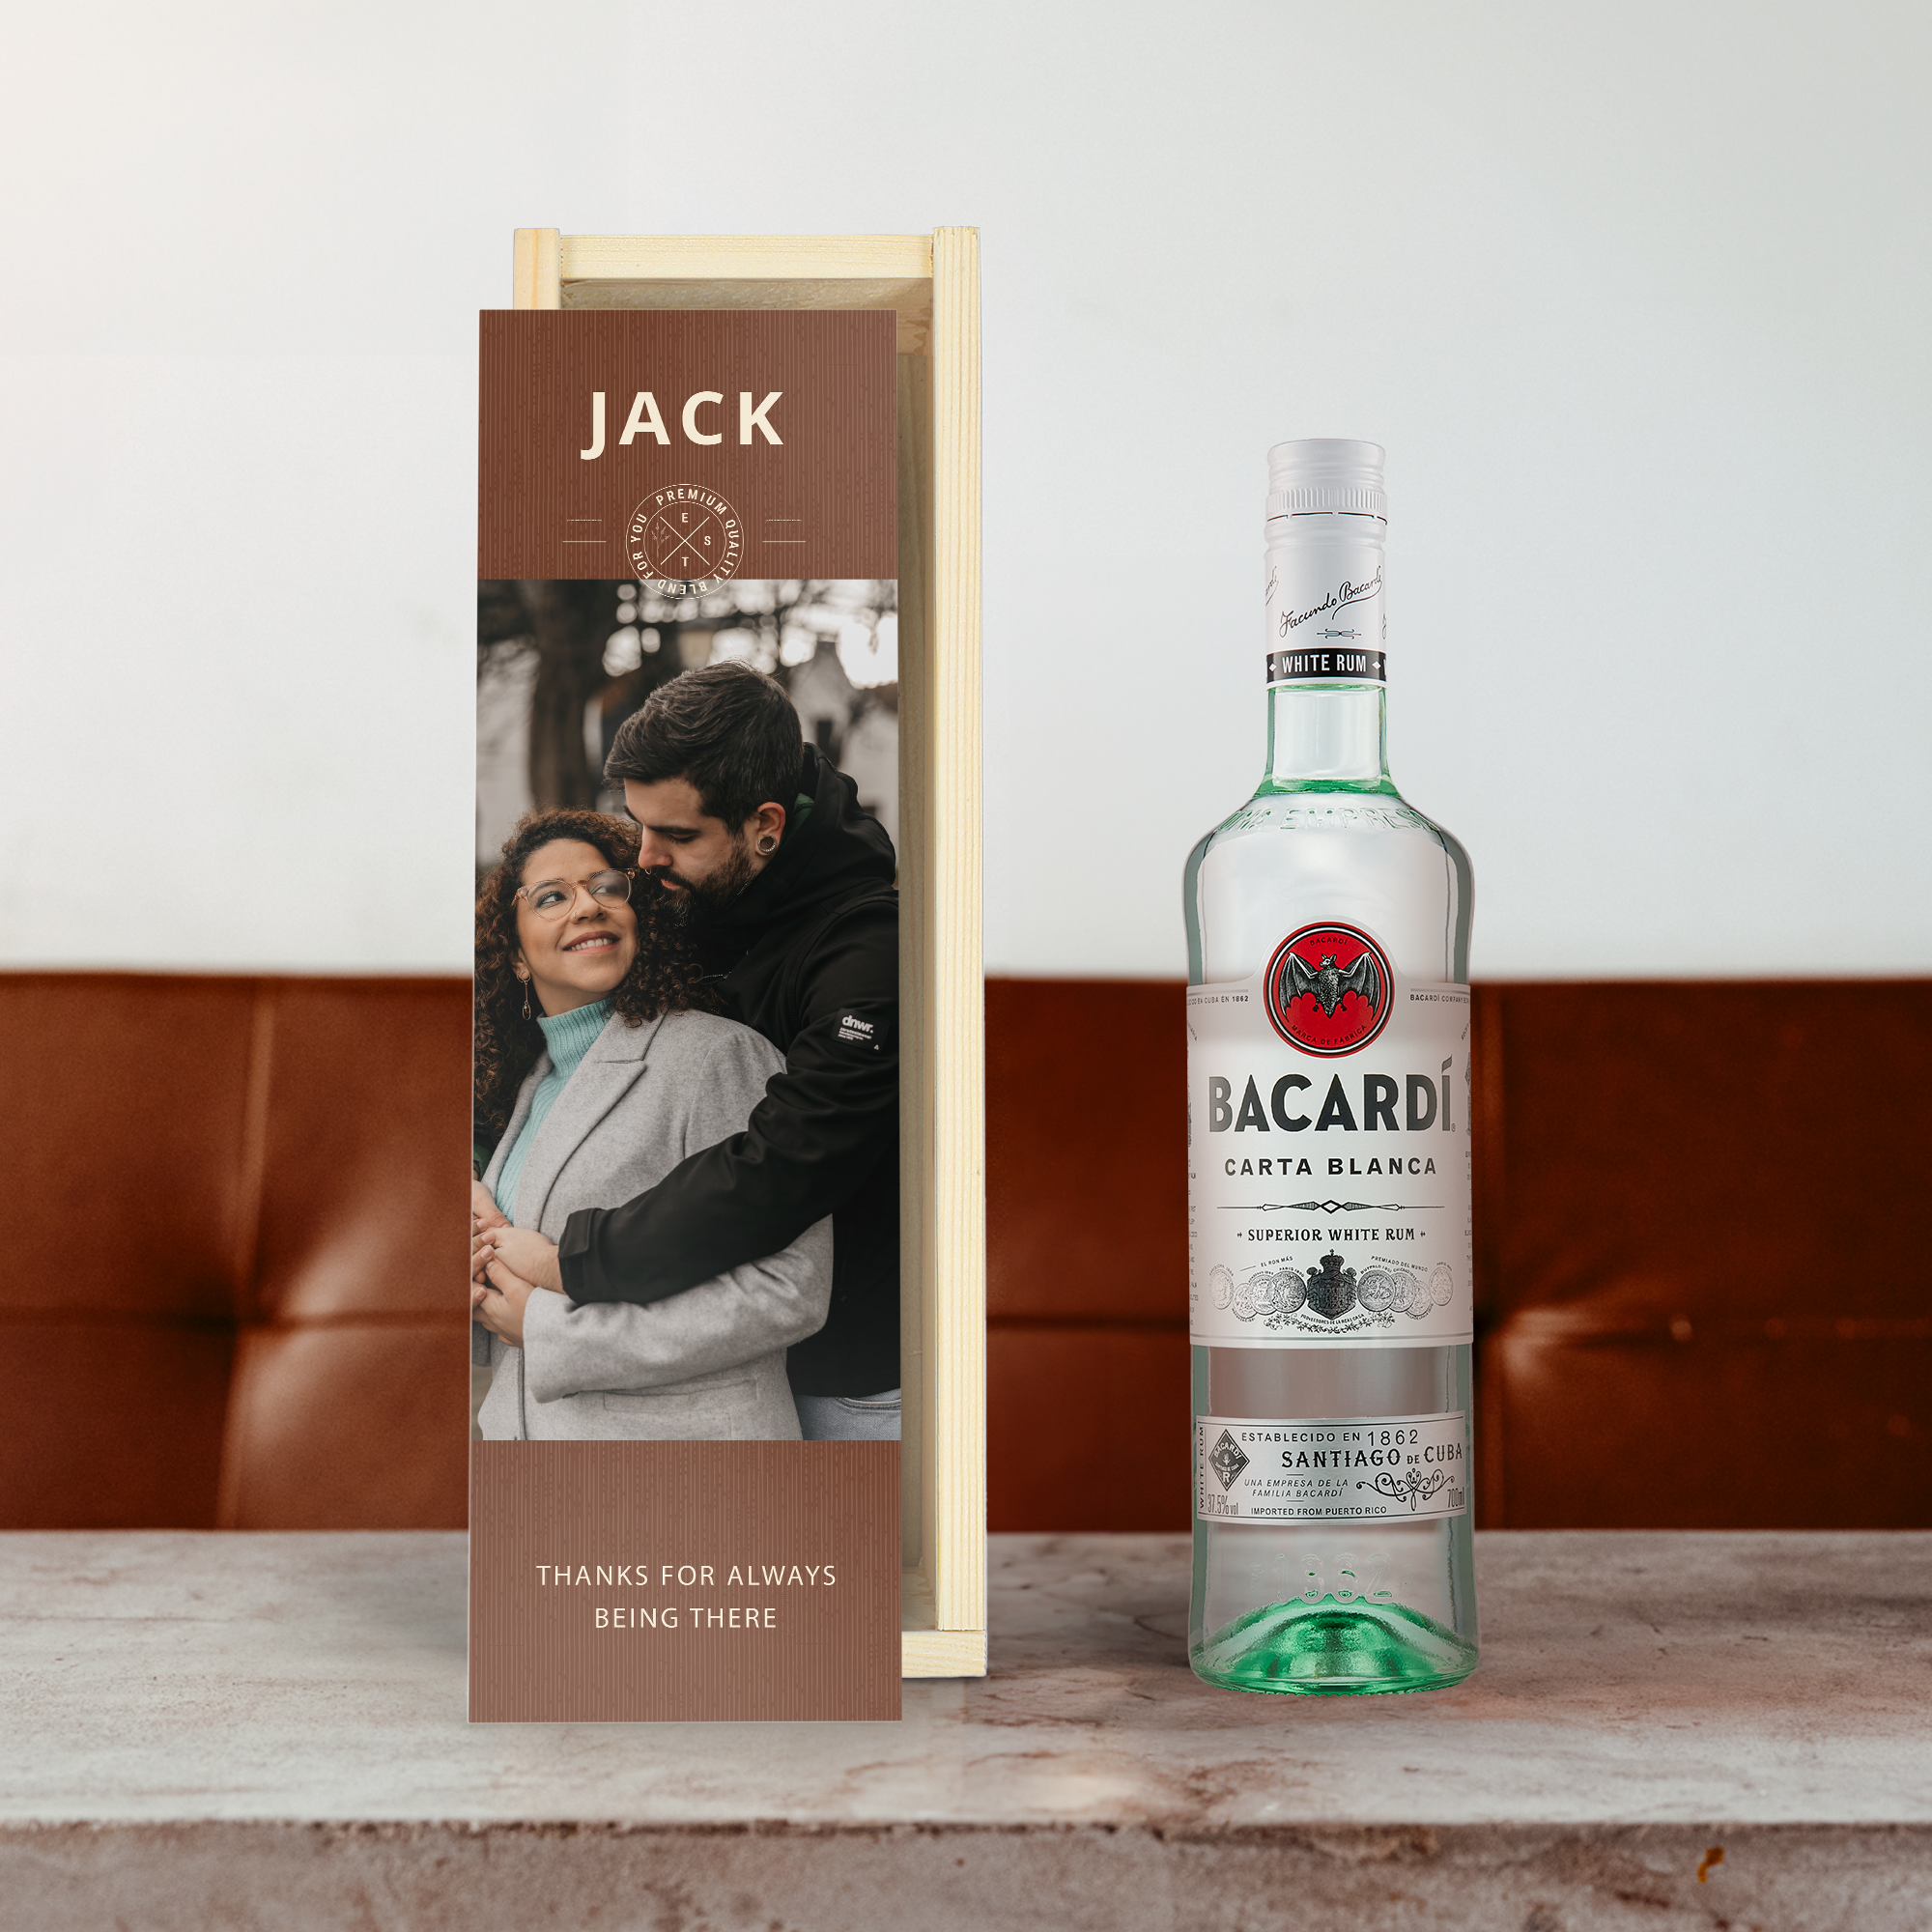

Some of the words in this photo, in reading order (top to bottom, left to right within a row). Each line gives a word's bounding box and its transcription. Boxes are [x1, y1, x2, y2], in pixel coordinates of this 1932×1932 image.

[581, 390, 784, 461] JACK
[655, 488, 727, 515] PREMIUM
[681, 512, 689, 523] E
[630, 513, 647, 543] YOU
[703, 535, 712, 546] S
[681, 556, 689, 567] T
[713, 519, 740, 584] QUALITY
[632, 552, 654, 580] FOR
[657, 579, 708, 595] BLEND
[1279, 592, 1338, 639] Facundo
[1281, 654, 1331, 674] WHITE
[1336, 654, 1367, 673] RUM
[1221, 995, 1230, 1004] EN
[1232, 994, 1249, 1003] 1862
[1409, 993, 1440, 1002] BACARDÍ
[841, 1014, 874, 1035] dnwr.
[1291, 1024, 1318, 1044] MARCA
[1320, 1037, 1331, 1046] DE
[1208, 1054, 1453, 1133] BACARDÍ
[1224, 1157, 1313, 1177] CARTA
[1327, 1157, 1437, 1176] BLANCA
[1247, 1228, 1323, 1242] SUPERIOR
[1327, 1228, 1380, 1242] WHITE
[1385, 1228, 1415, 1241] RUM
[1371, 1255, 1400, 1266] PREMIADO
[1241, 1432, 1336, 1443] ESTABLECIDO
[1343, 1432, 1361, 1442] EN
[1367, 1429, 1419, 1447] 1862
[1281, 1447, 1402, 1469] SANTIAGO
[1406, 1454, 1420, 1465] DE
[1423, 1442, 1463, 1463] CUBA
[1244, 1478, 1264, 1488] UNA
[1266, 1478, 1314, 1488] EMPRESA
[1318, 1478, 1332, 1488] DE
[1336, 1478, 1349, 1488] LA
[1252, 1489, 1293, 1498] FAMILIA
[1295, 1487, 1344, 1498] BACARDÍ
[1208, 1493, 1230, 1515] 37.5%
[1230, 1502, 1239, 1516] vol
[1251, 1507, 1294, 1516] IMPORTED
[1296, 1507, 1322, 1516] FROM
[1325, 1506, 1363, 1516] PUERTO
[1366, 1506, 1387, 1515] RICO
[536, 1565, 648, 1586] THANKS
[662, 1565, 715, 1586] FOR
[726, 1565, 837, 1586] ALWAYS
[595, 1607, 678, 1629] BEING
[689, 1607, 777, 1629] THERE
